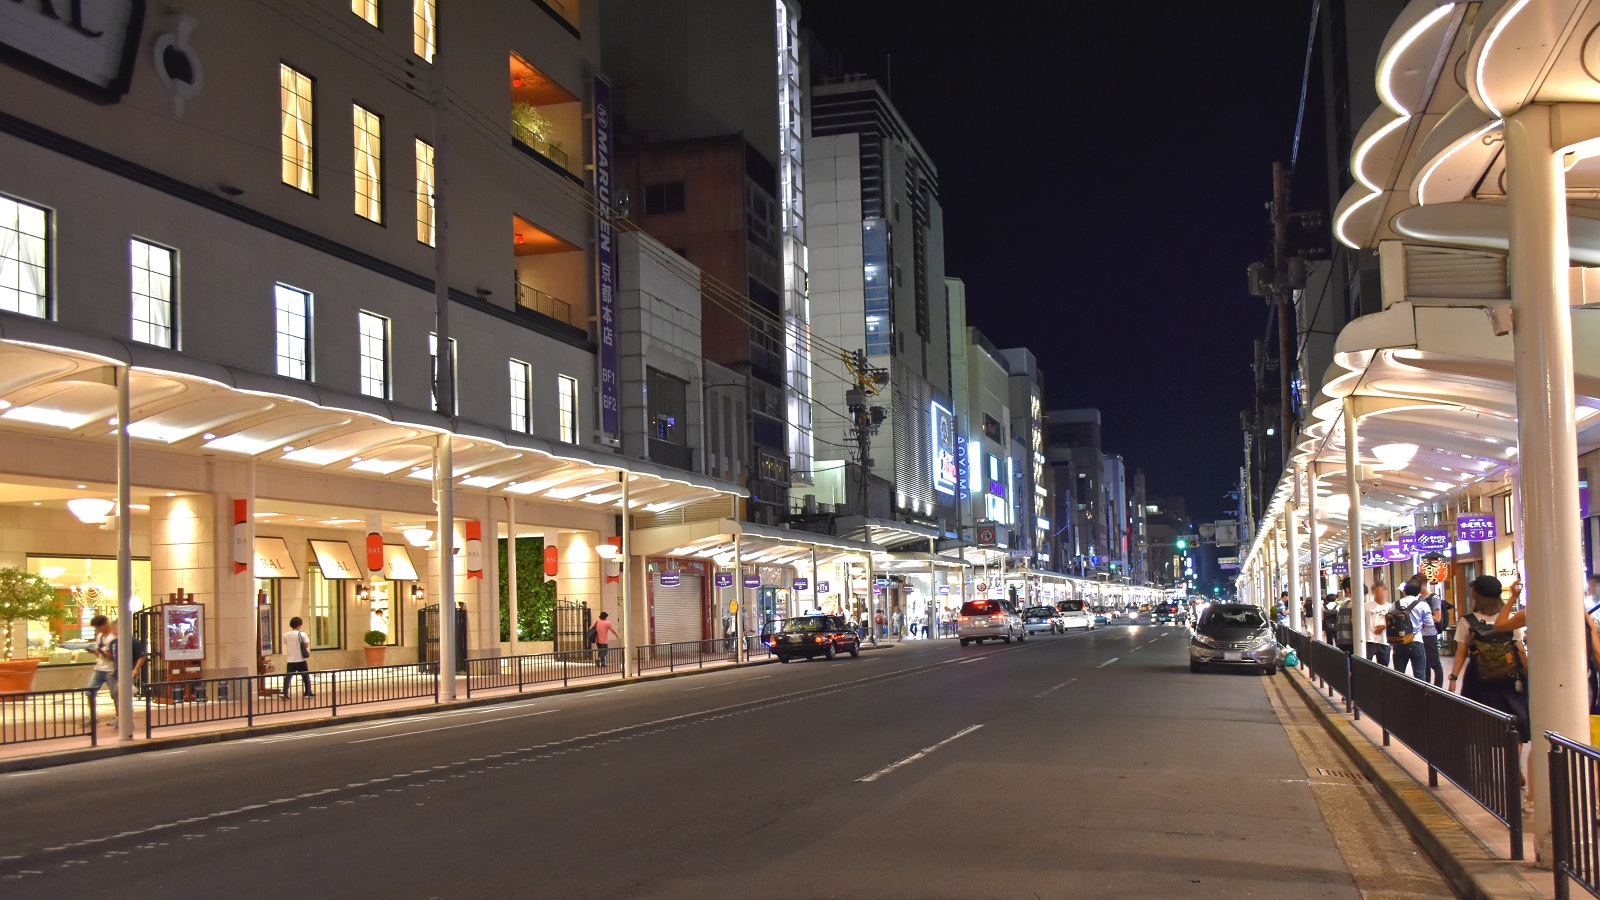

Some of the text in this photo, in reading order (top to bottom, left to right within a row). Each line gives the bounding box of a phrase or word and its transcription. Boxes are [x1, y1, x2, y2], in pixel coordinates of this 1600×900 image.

[598, 128, 611, 253] MARUZEN
[601, 262, 613, 347] 京都本店
[602, 368, 615, 385] BF1
[603, 394, 617, 411] BF2
[957, 435, 968, 500] AOYAMA
